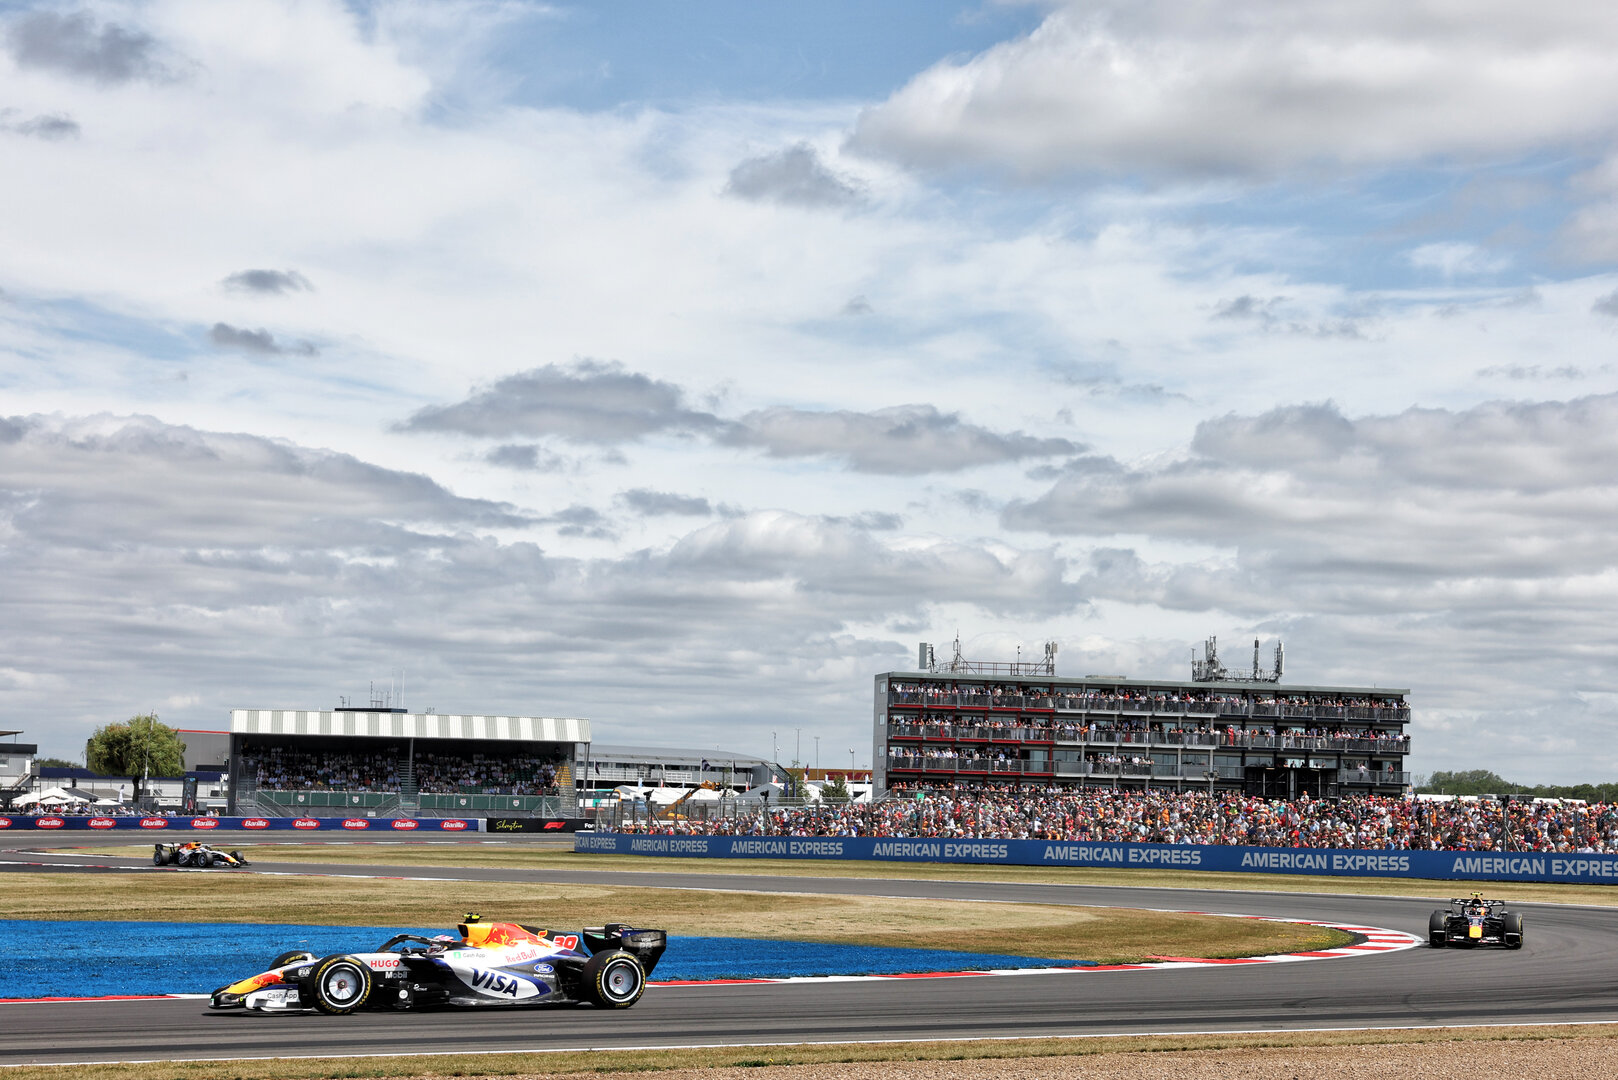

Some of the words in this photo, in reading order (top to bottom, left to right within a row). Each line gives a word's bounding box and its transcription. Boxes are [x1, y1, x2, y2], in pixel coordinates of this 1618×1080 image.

[590, 837, 616, 849] EXPRESS
[631, 840, 668, 852] AMERICAN
[670, 840, 708, 852] EXPRESS
[731, 841, 787, 854] AMERICAN
[790, 842, 843, 855] EXPRESS
[872, 843, 940, 857] AMERICAN
[944, 844, 1008, 858] EXPRESS
[1044, 846, 1123, 862] AMERICAN
[1128, 848, 1201, 865] EXPRESS
[1241, 852, 1327, 868] AMERICAN
[1333, 855, 1410, 871] EXPRESS
[1452, 857, 1545, 874] AMERICAN
[554, 936, 577, 949] 30
[506, 954, 521, 963] Red
[521, 949, 536, 960] Bull
[470, 967, 518, 997] VISA
